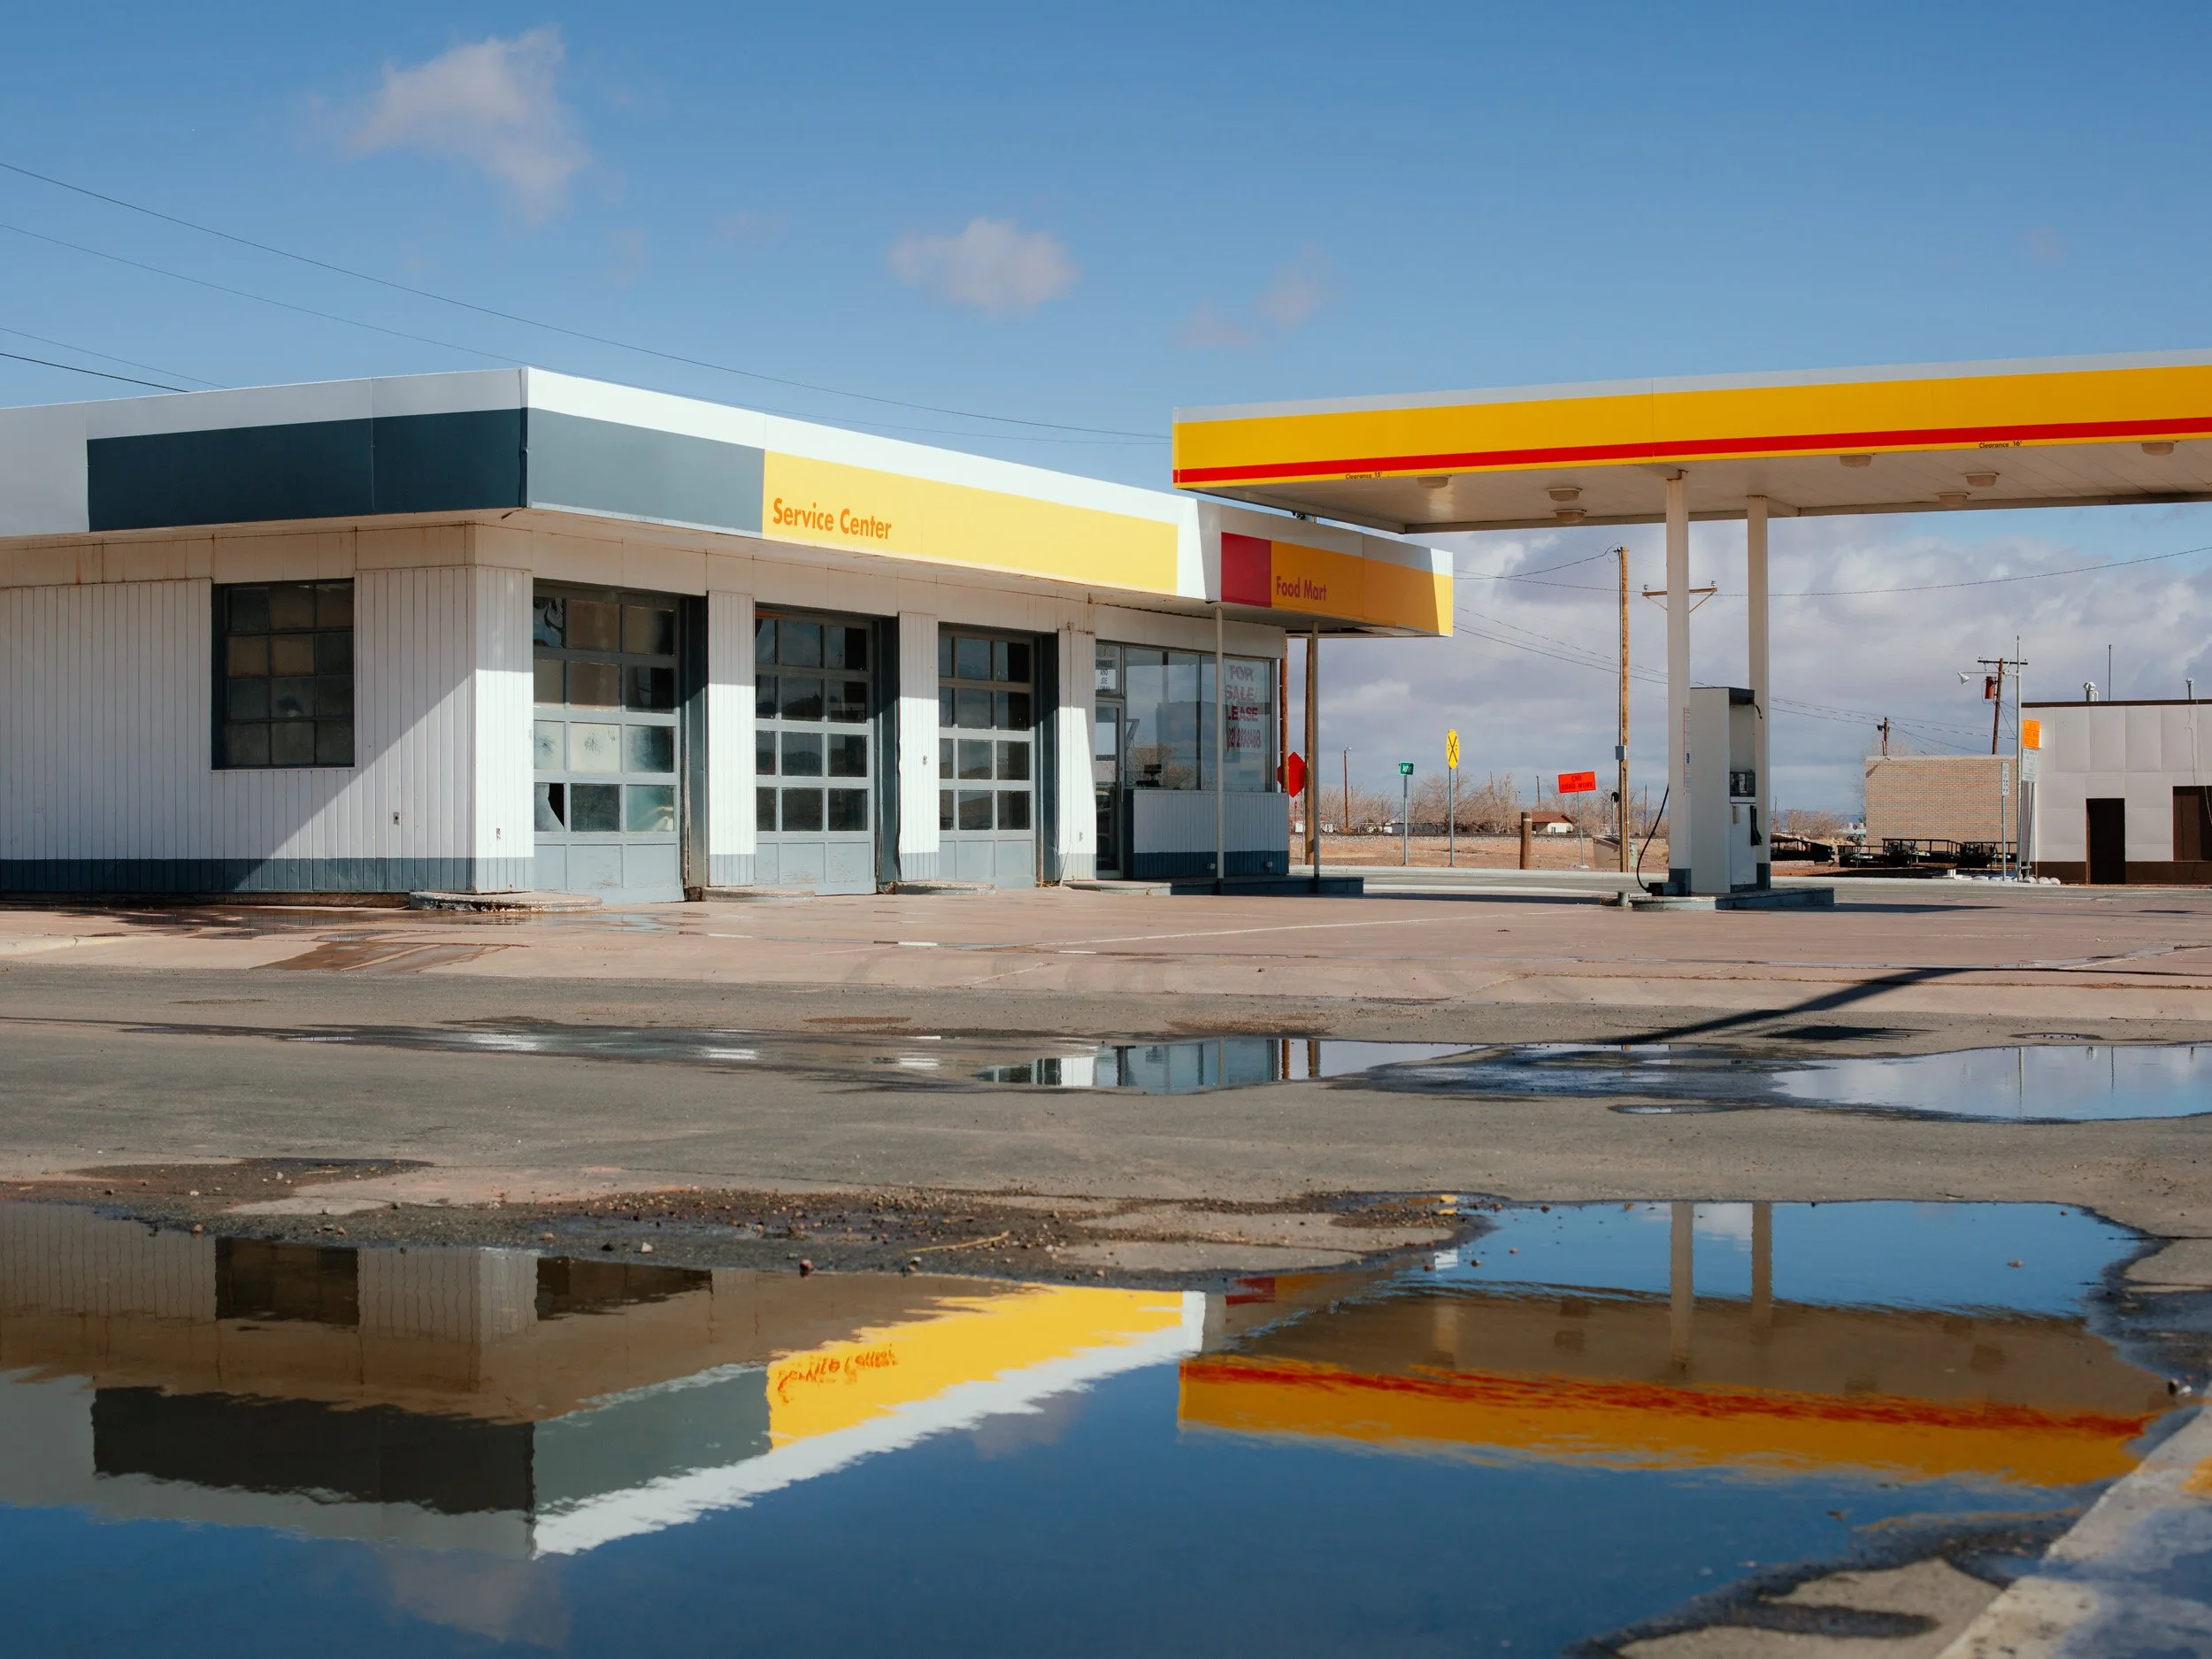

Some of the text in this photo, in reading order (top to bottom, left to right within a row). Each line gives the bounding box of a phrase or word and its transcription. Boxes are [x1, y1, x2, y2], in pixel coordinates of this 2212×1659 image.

[772, 497, 892, 539] Service Center
[1276, 575, 1327, 602] Food Mart
[1229, 664, 1254, 681] FOR
